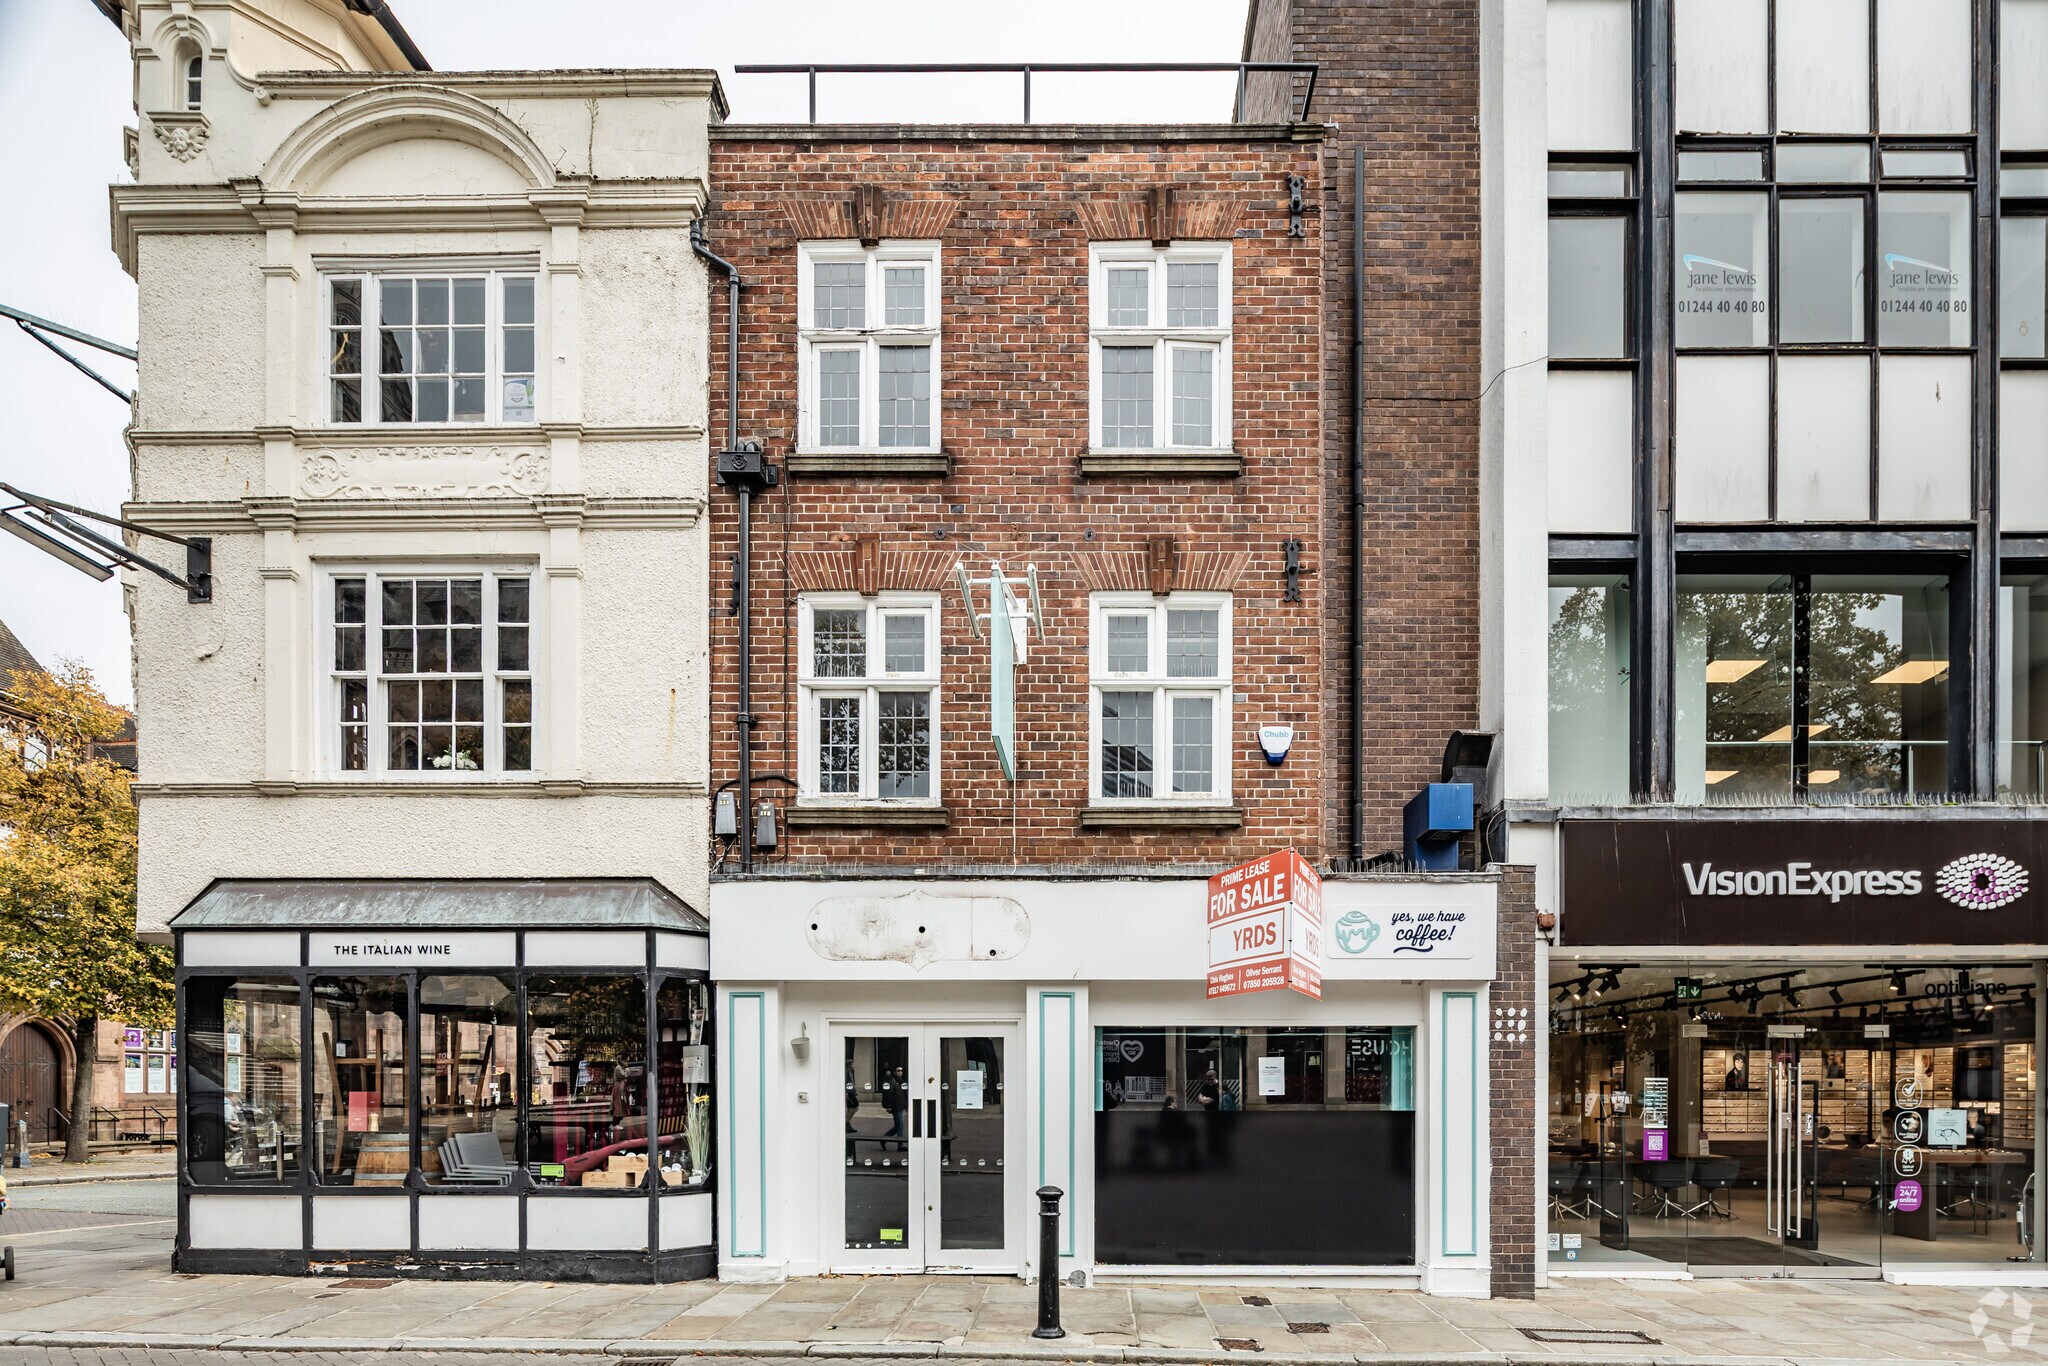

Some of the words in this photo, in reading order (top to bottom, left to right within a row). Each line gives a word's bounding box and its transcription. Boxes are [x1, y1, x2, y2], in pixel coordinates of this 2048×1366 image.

[1687, 270, 1718, 288] jane
[1723, 269, 1757, 285] lewis
[1889, 269, 1920, 288] jane
[1925, 269, 1959, 285] lewis
[1678, 300, 1713, 313] 01244
[1716, 300, 1730, 313] 40
[1734, 300, 1748, 313] 40
[1751, 300, 1765, 313] 80
[1881, 300, 1915, 313] 01244
[1919, 300, 1933, 313] 40
[1936, 300, 1950, 313] 40
[1953, 300, 1967, 313] 80
[1264, 730, 1289, 738] Chubb
[1221, 868, 1244, 888] PRIME
[1245, 860, 1270, 880] LEASE
[1682, 862, 1923, 904] VisionExpress
[1210, 888, 1236, 920] FOR
[1240, 873, 1285, 910] SALE
[1294, 873, 1307, 909] FOR
[1308, 886, 1321, 921] SALE
[1391, 911, 1415, 926] yes,
[1417, 912, 1435, 922] we
[1436, 910, 1466, 922] have
[1233, 921, 1276, 951] YRDS
[1305, 928, 1320, 958] YRDS
[1396, 923, 1457, 946] coffee!
[334, 945, 358, 955] THE
[363, 945, 412, 955] ITALIAN
[417, 945, 451, 954] WINE
[1245, 968, 1261, 978] Oliver
[1261, 964, 1282, 976] Serrant
[1261, 975, 1285, 987] 205928
[1925, 979, 2007, 999] opticians
[1900, 1189, 1917, 1198] 24/7
